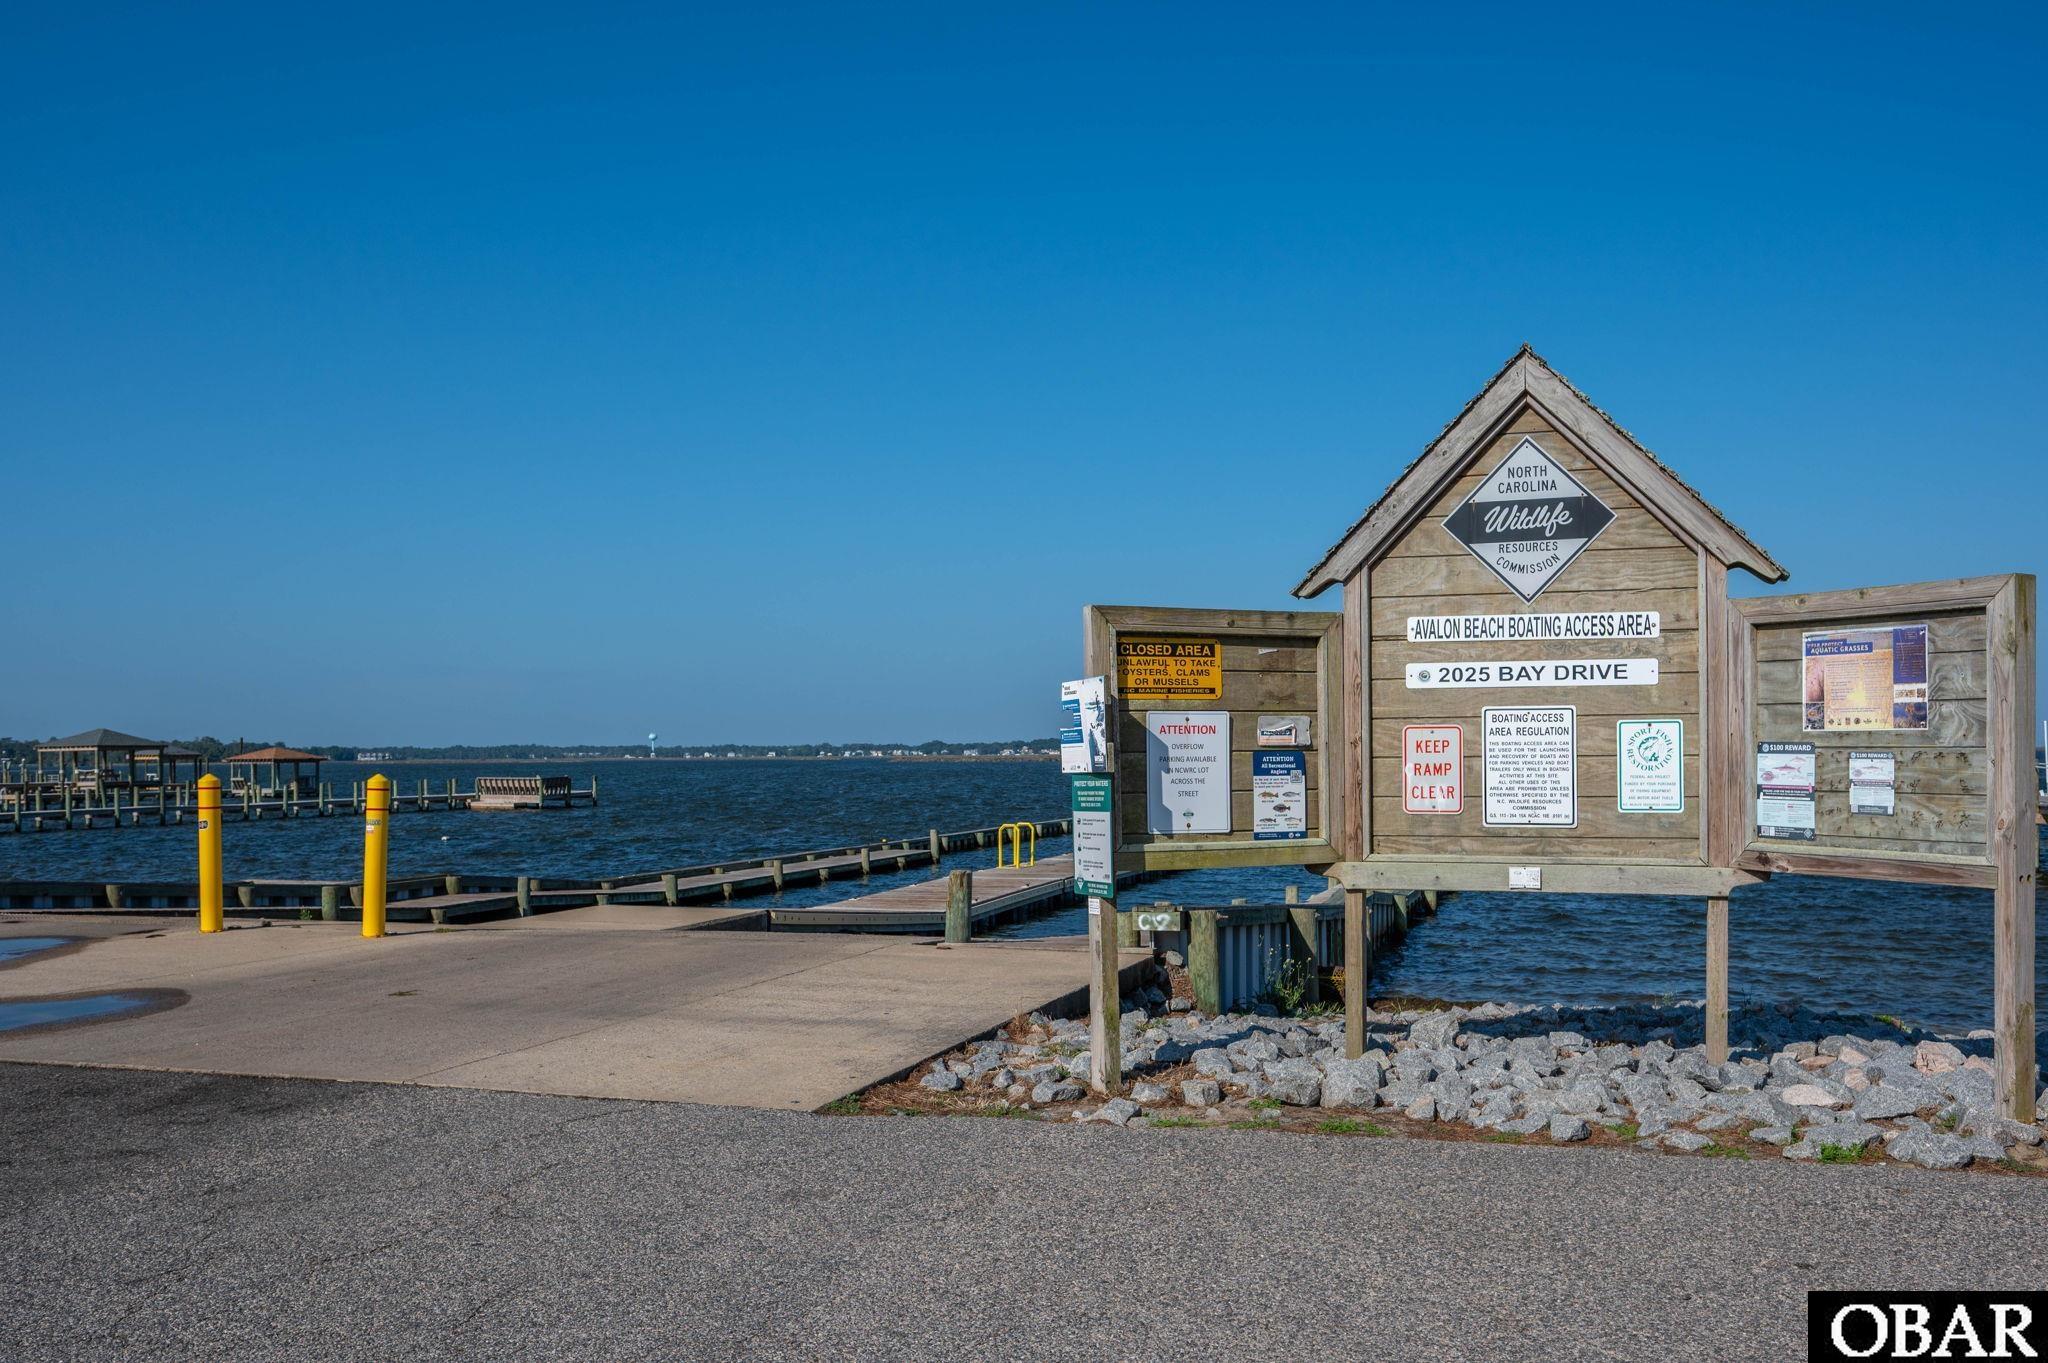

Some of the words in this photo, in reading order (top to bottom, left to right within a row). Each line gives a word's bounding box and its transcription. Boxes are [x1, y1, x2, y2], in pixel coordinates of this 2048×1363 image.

[1508, 465, 1547, 478] NORTH
[1498, 480, 1557, 494] CAROLINA
[1484, 502, 1573, 537] Wildlife
[1498, 541, 1558, 553] RESOURCES
[1496, 553, 1561, 574] COMMISSION
[1414, 618, 1461, 639] AVALON
[1464, 617, 1504, 638] BEACH
[1508, 616, 1561, 638] BOATING
[1565, 615, 1614, 637] ACCESS
[1618, 614, 1652, 636] AREA
[1121, 644, 1172, 655] CLOSED
[1176, 646, 1211, 656] AREA
[1438, 667, 1490, 683] 2025
[1499, 666, 1546, 682] BAY
[1554, 664, 1628, 680] DRIVE
[1492, 714, 1528, 722] BOATING
[1530, 714, 1564, 722] ACCESS
[1160, 725, 1216, 734] ATTENTION
[1489, 727, 1512, 736] AREA
[1516, 727, 1569, 736] REGULATION
[1628, 728, 1651, 746] SPORT
[1656, 729, 1672, 746] FISH
[1416, 740, 1450, 753] KEEP
[1627, 748, 1672, 771] RESTORATION
[1414, 763, 1452, 776] RAMP
